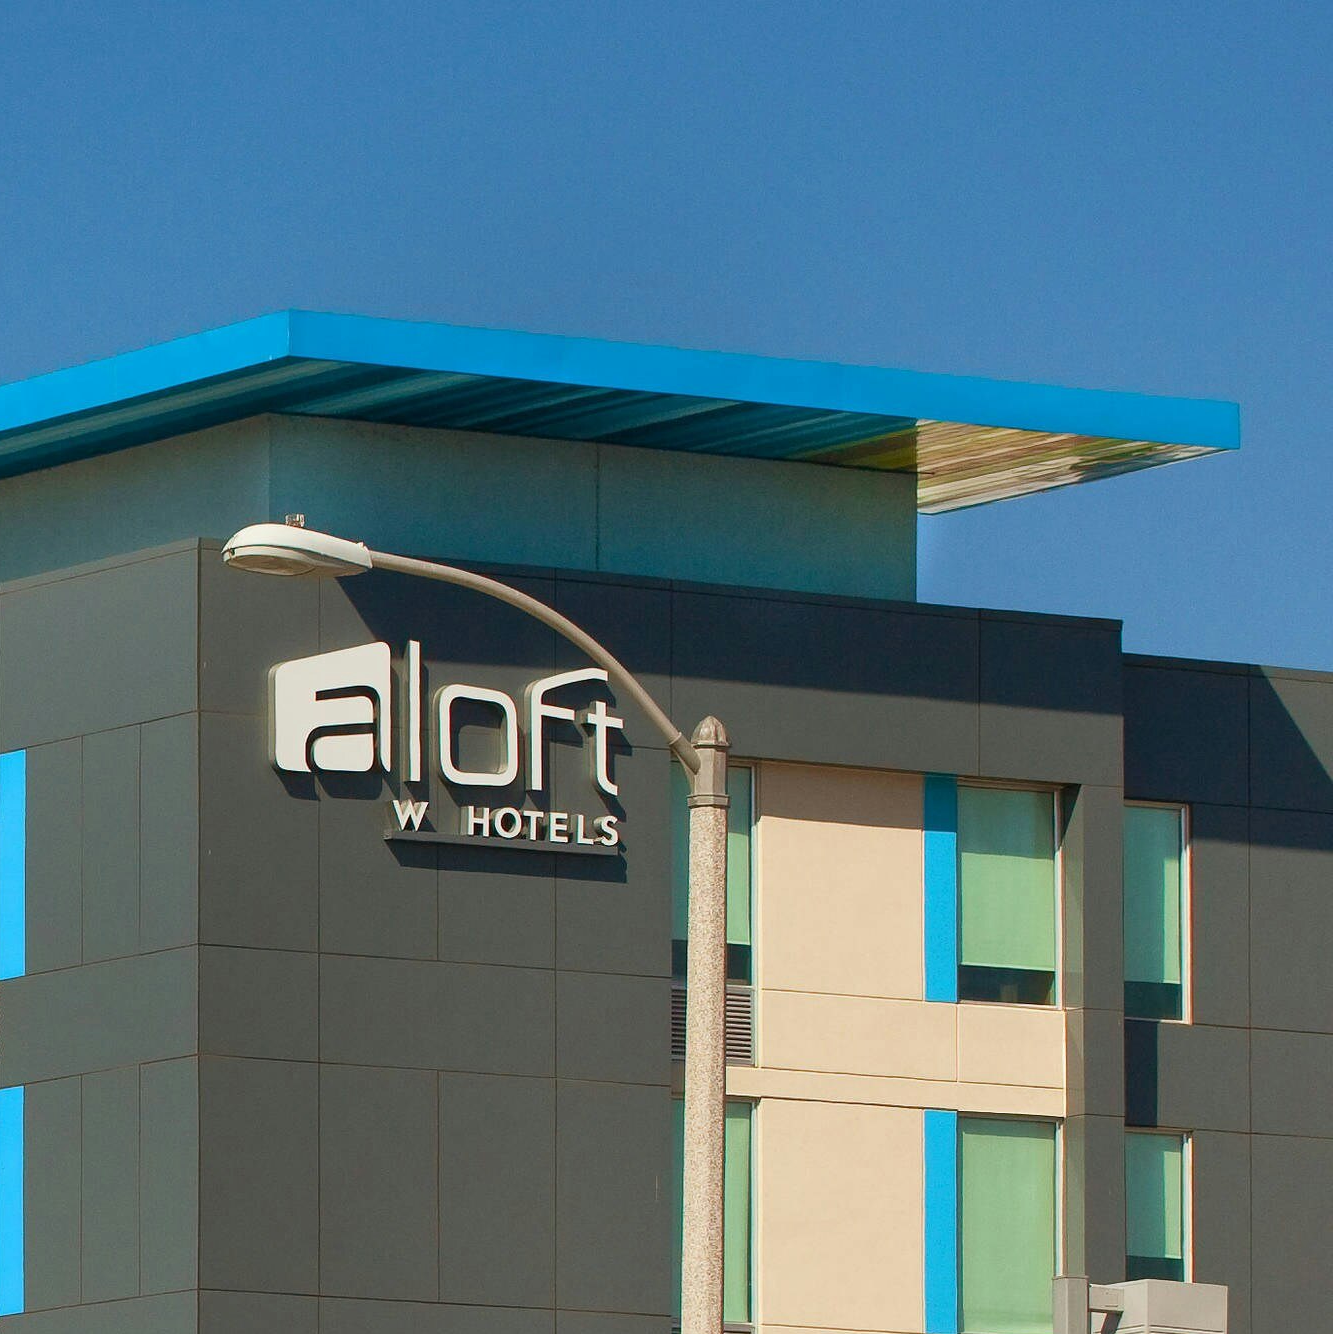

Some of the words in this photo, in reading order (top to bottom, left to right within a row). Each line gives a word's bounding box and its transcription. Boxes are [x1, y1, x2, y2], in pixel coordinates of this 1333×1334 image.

[273, 640, 624, 796] aloft
[392, 799, 429, 831] W
[466, 804, 619, 847] HOTELS
